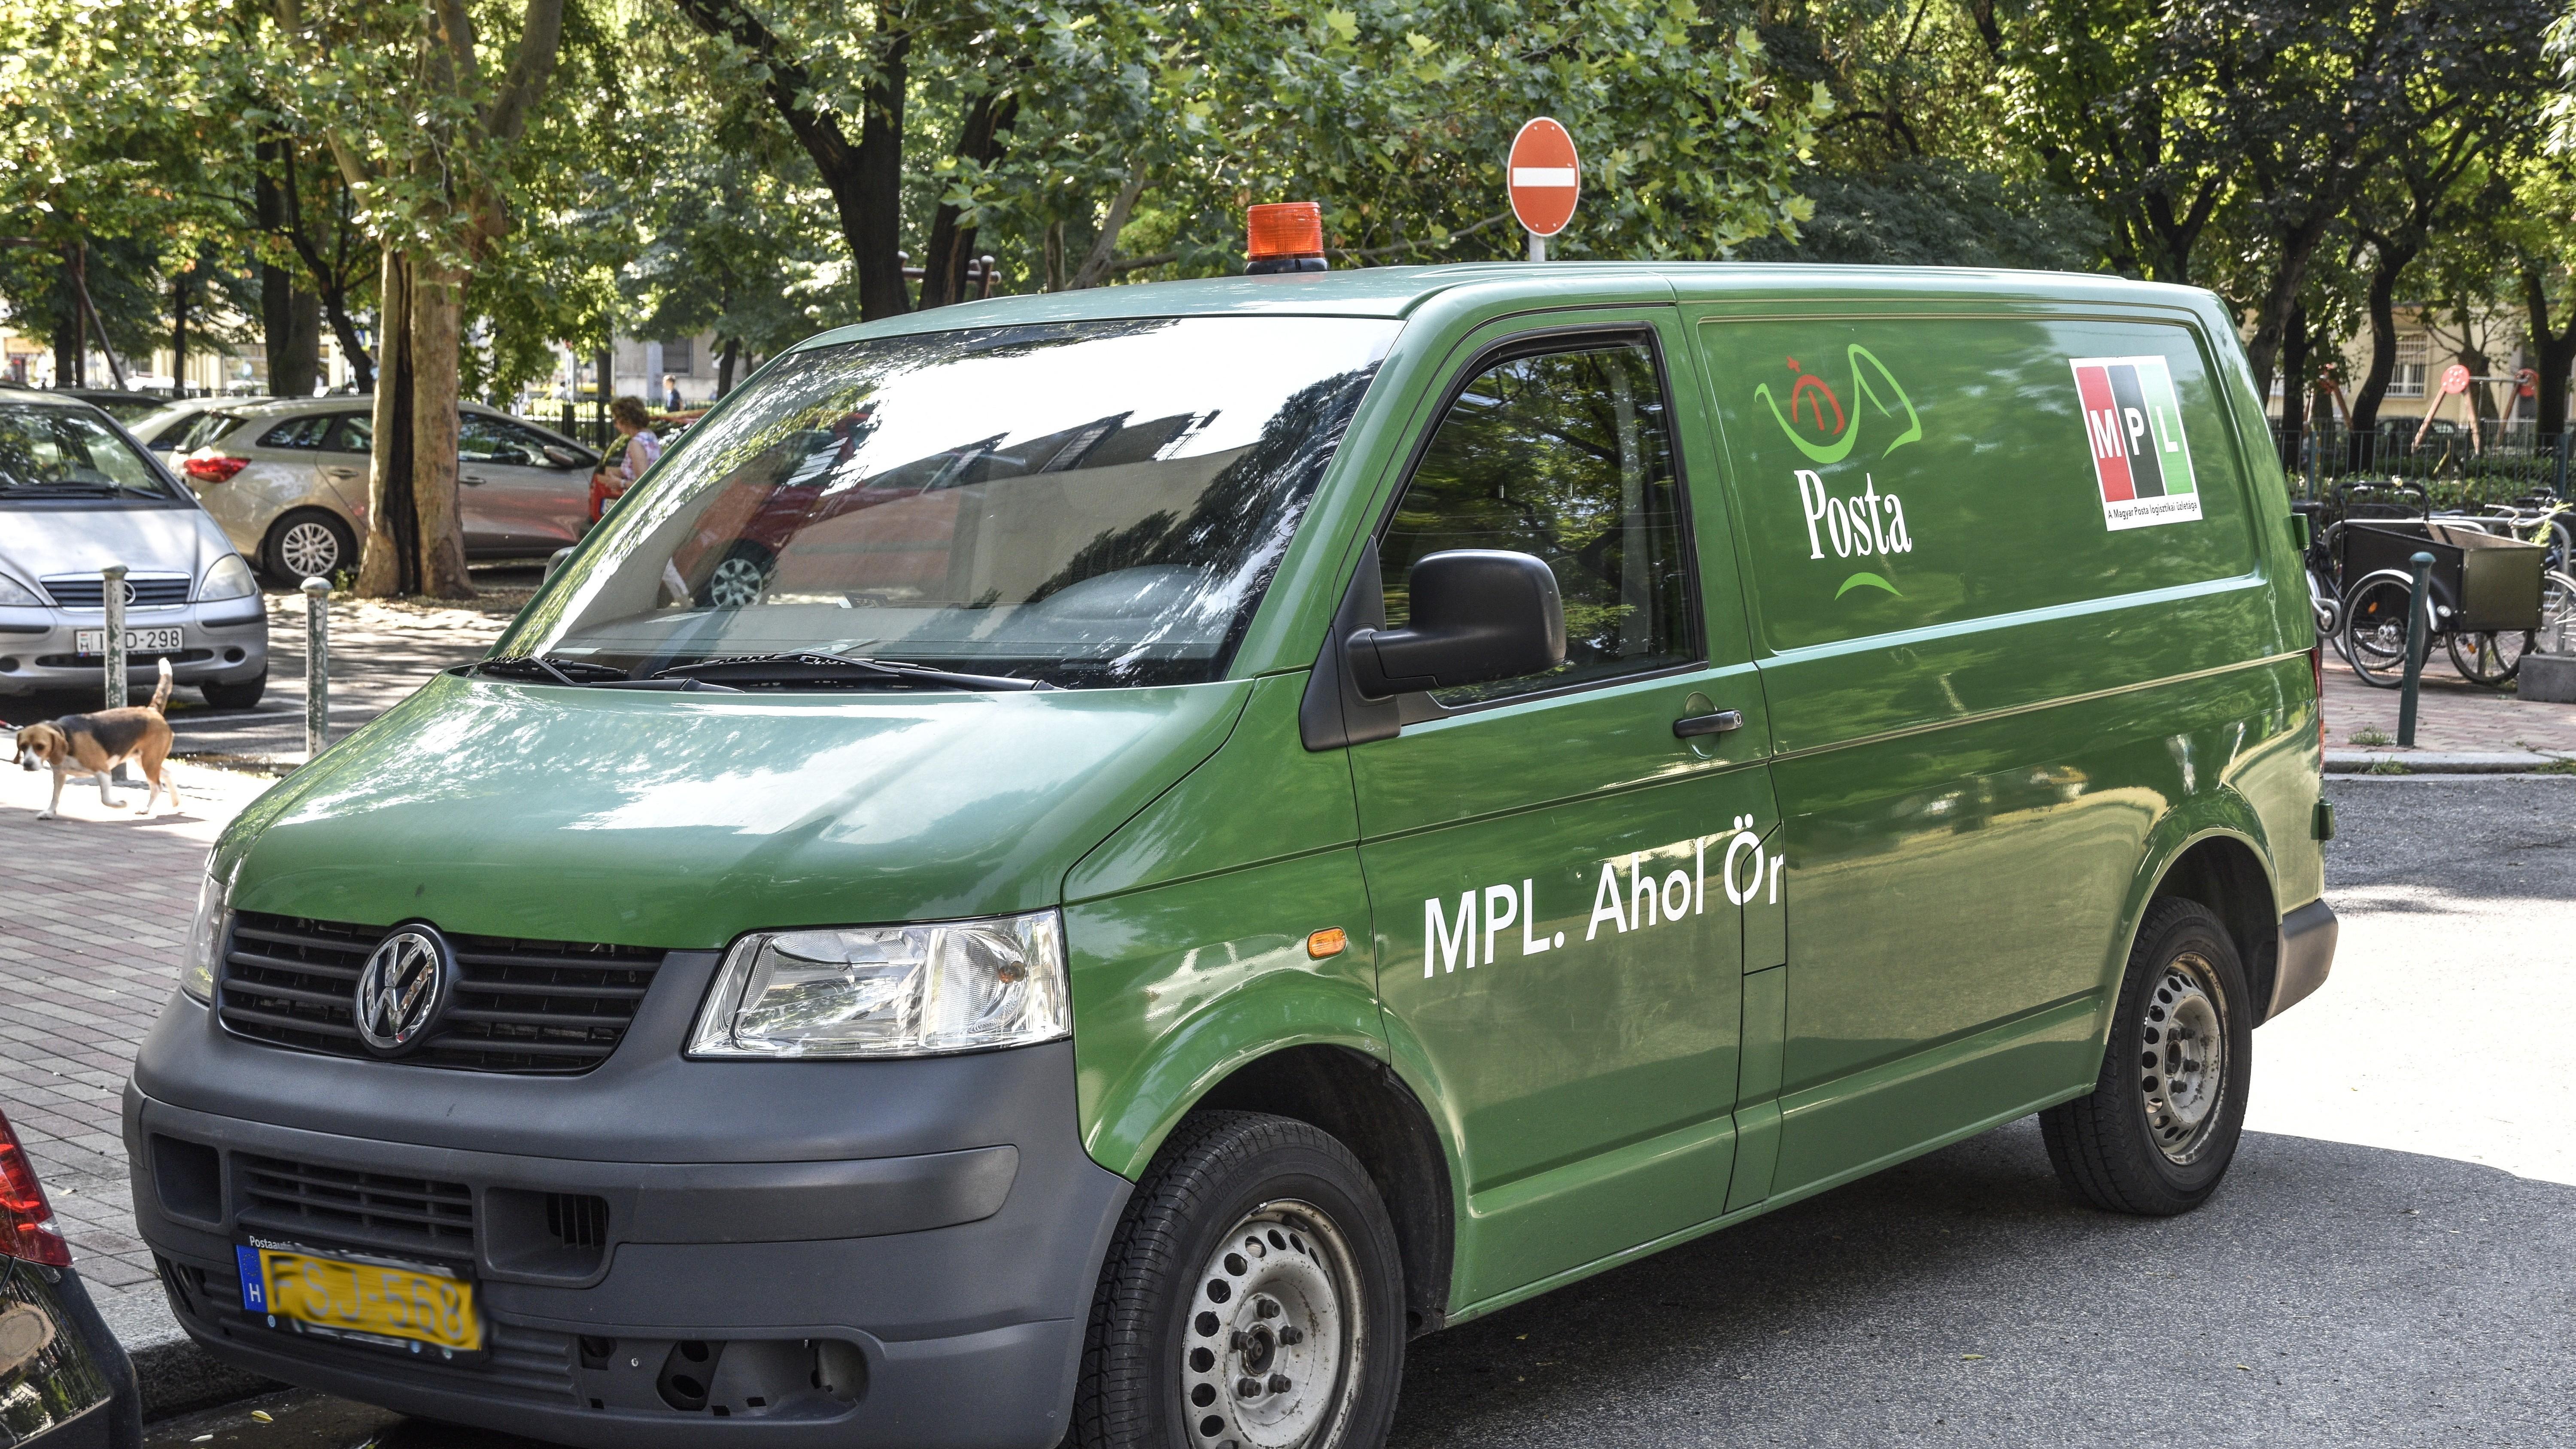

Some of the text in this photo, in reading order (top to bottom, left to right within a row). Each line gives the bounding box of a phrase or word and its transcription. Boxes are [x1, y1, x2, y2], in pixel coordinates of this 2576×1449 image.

[2090, 406, 2179, 458] MPL
[1794, 470, 1912, 559] Posta
[2108, 500, 2197, 519] A Magyar Posta logisztikai üzletága
[1424, 813, 1784, 979] MPL. Ahol Ör
[249, 1283, 261, 1303] H
